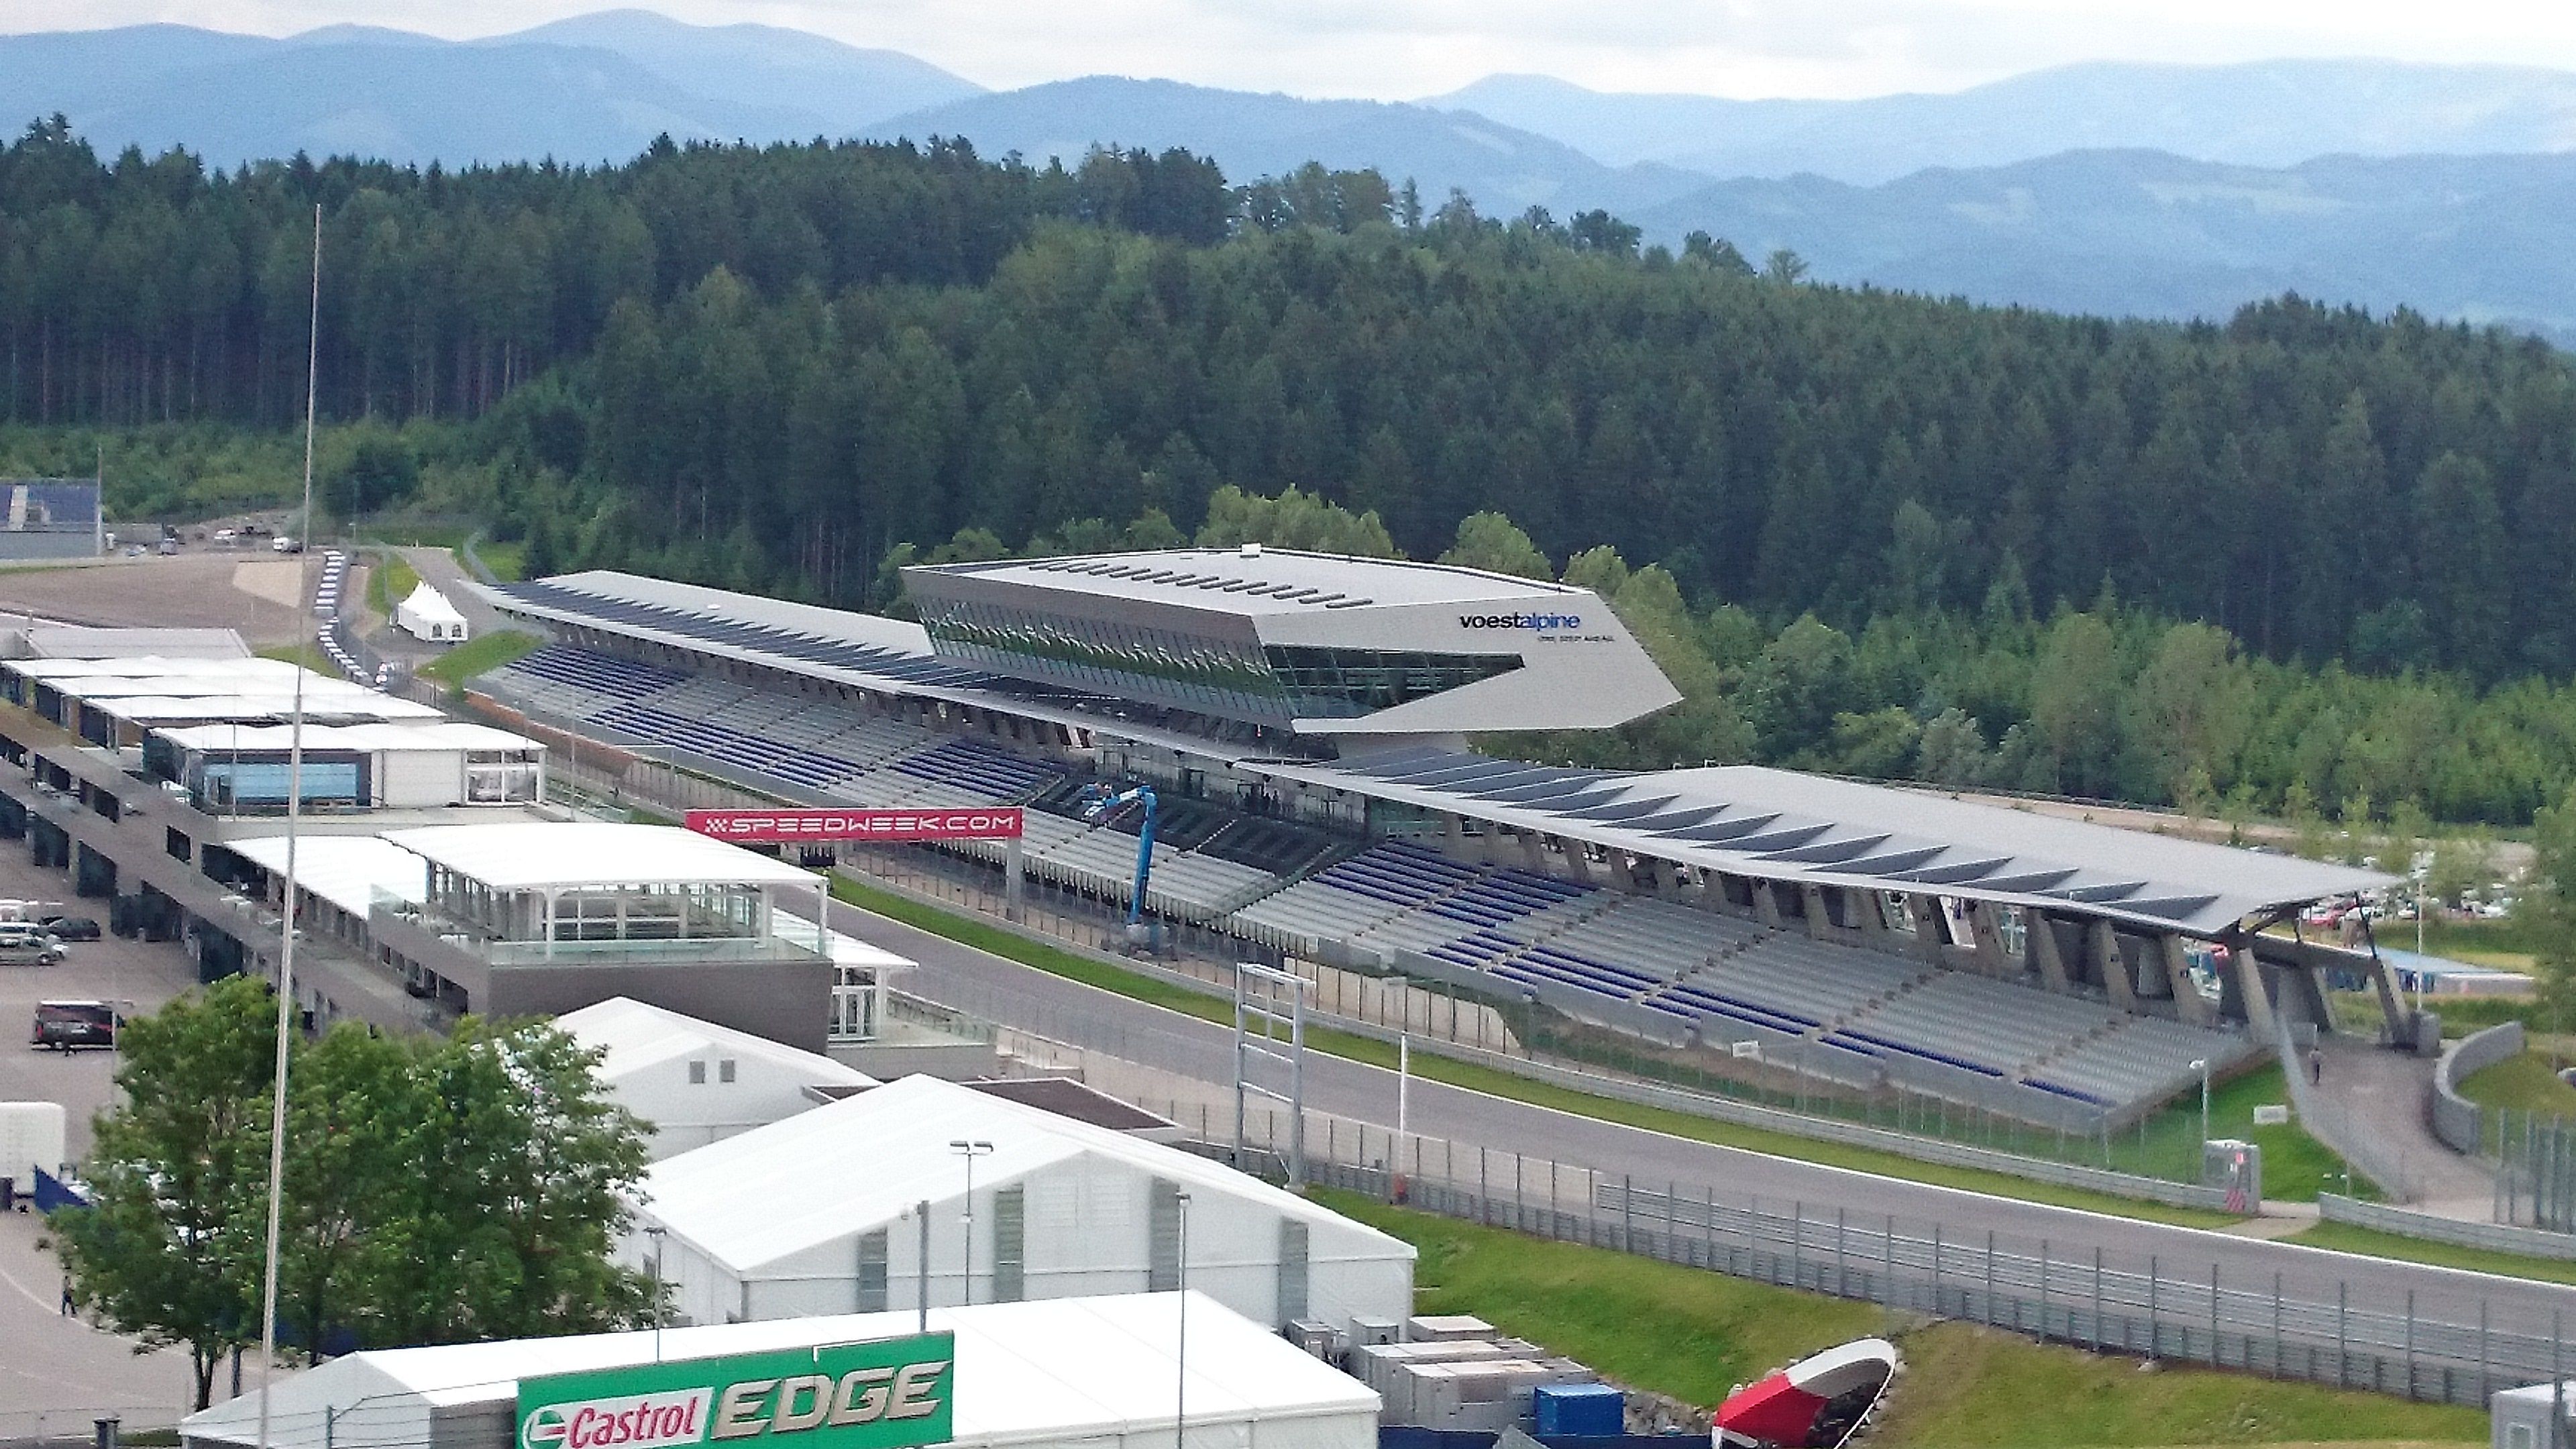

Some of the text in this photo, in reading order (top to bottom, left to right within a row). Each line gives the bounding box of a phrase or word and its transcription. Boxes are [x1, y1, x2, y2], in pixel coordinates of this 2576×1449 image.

[1459, 611, 1580, 632] voestalpine
[730, 816, 1014, 834] SPEEDWEEK.COM
[570, 1361, 951, 1449] Castrol EDGE
